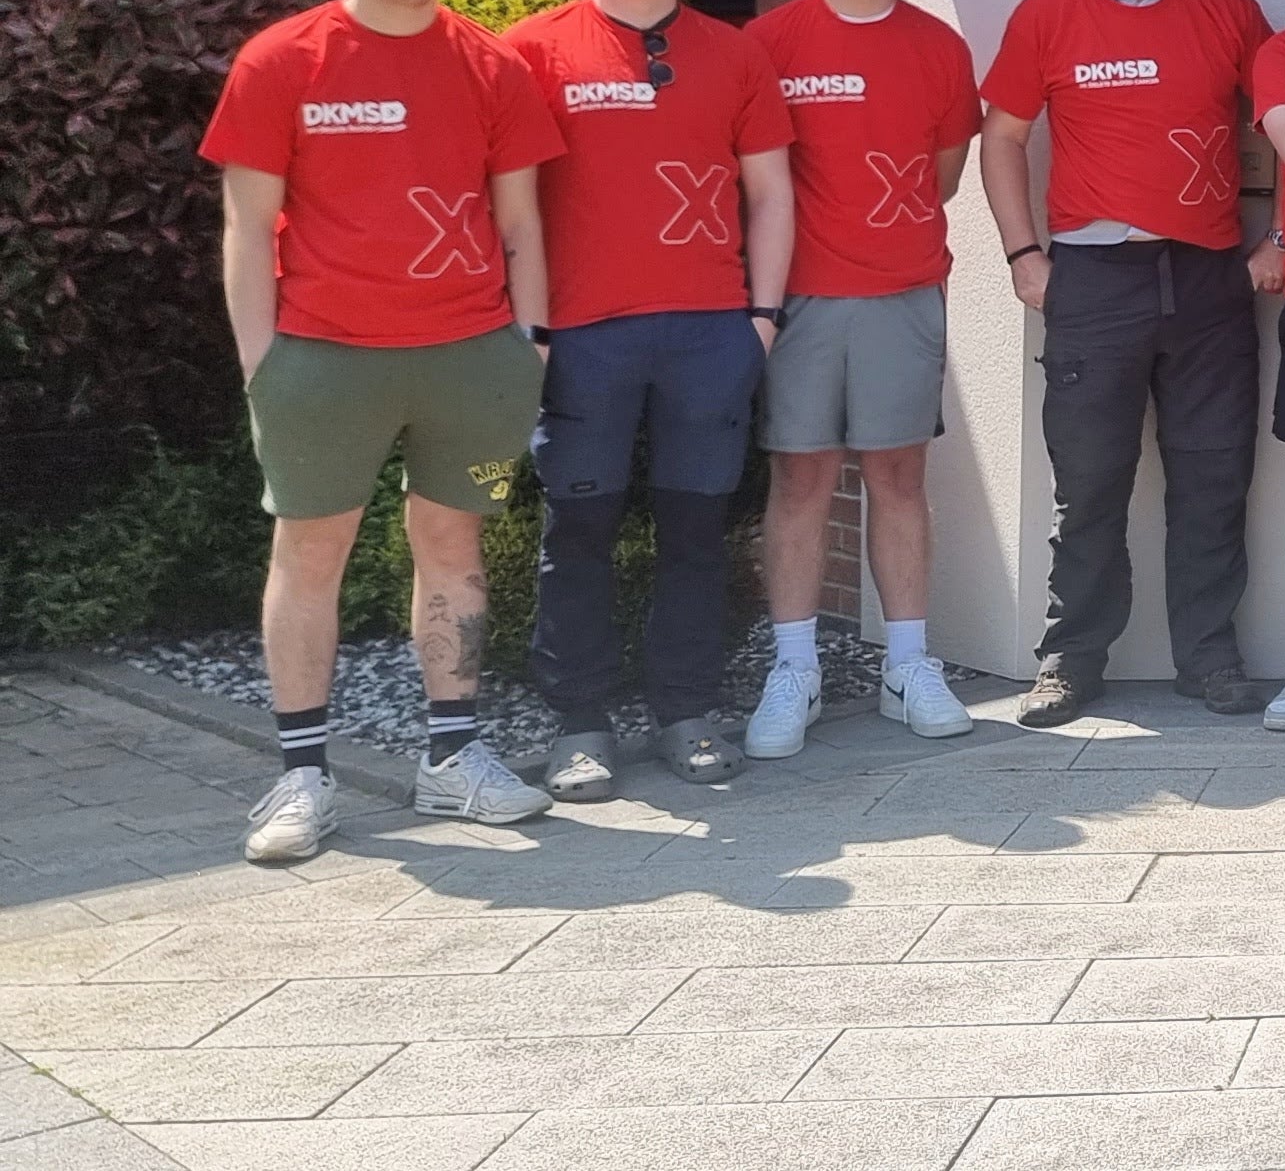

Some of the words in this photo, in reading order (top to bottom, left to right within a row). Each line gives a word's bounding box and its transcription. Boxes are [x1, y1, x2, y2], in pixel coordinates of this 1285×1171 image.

[1074, 60, 1139, 84] DKMS
[564, 82, 634, 107] DKMS
[779, 76, 845, 98] DKMS
[302, 101, 381, 126] DKMS
